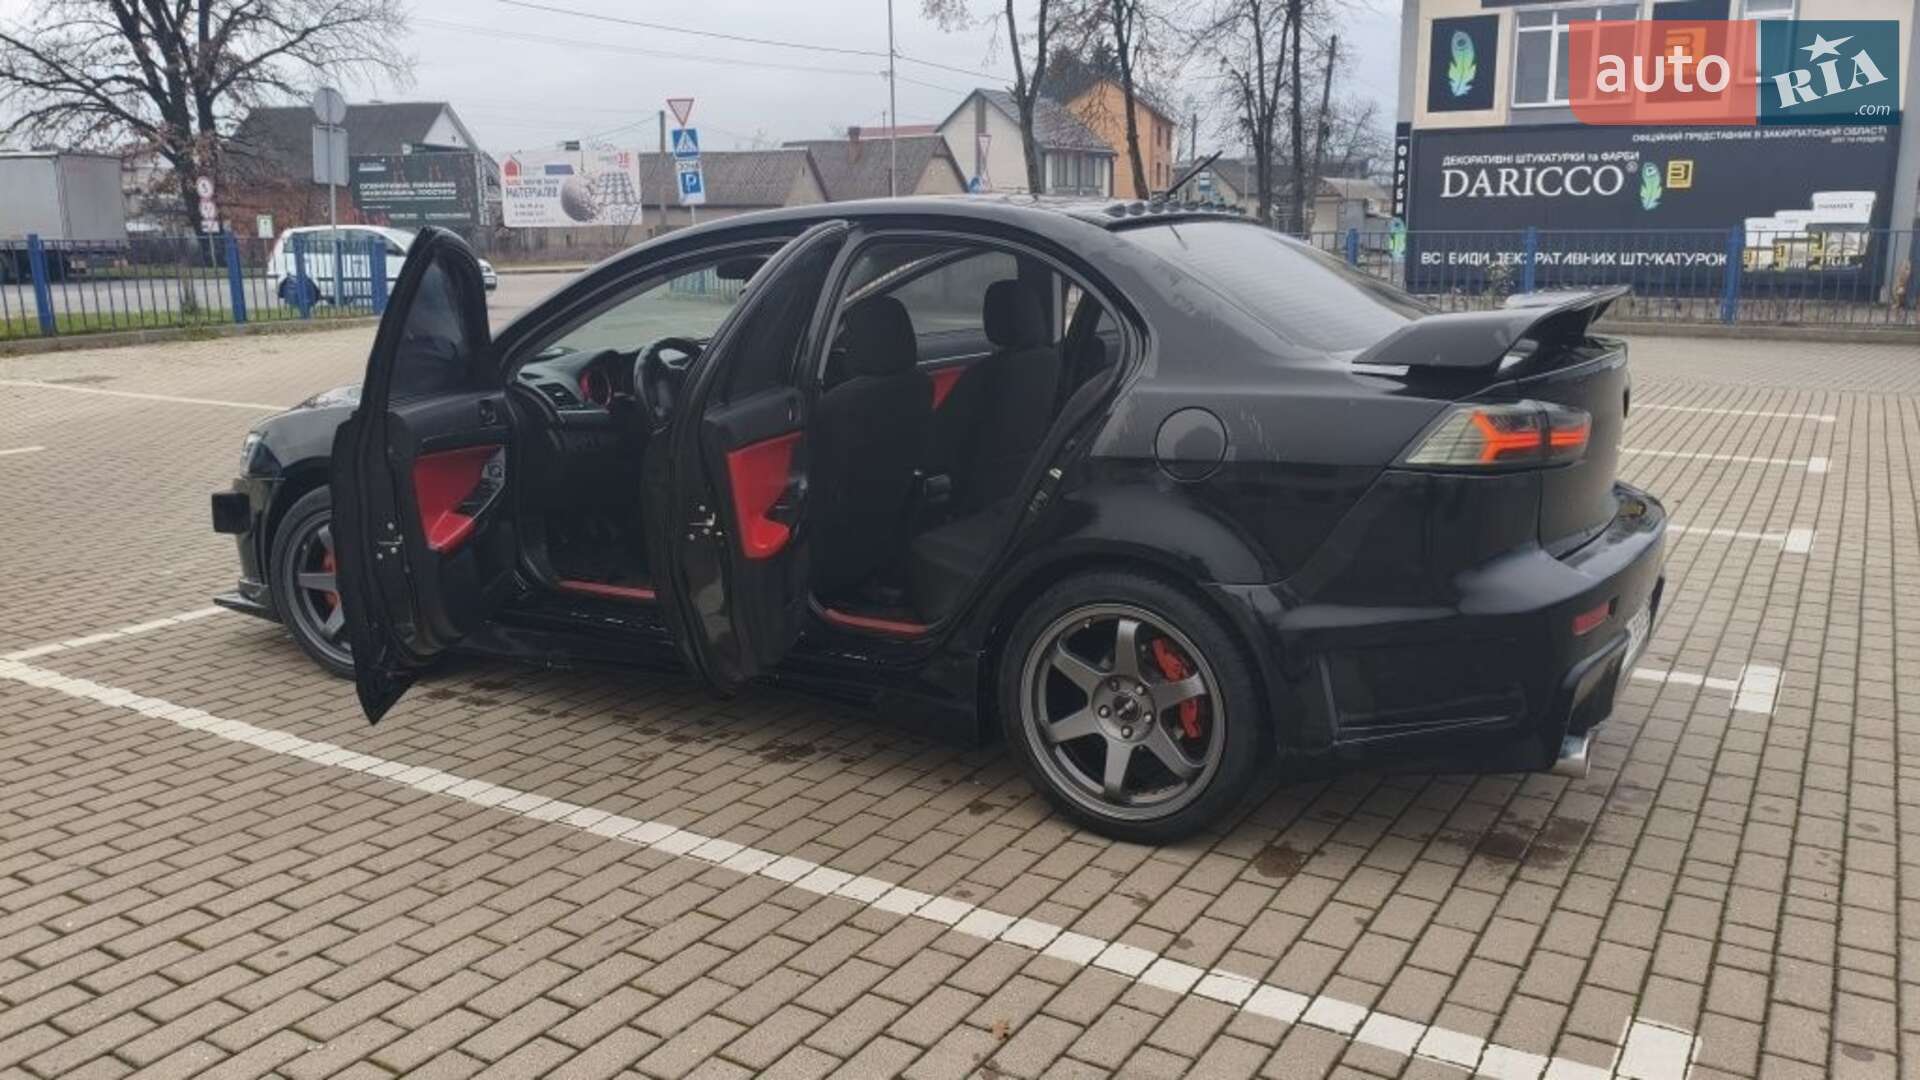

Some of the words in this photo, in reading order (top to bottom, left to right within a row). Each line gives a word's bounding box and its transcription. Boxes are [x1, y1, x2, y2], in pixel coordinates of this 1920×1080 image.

[1442, 154, 1513, 166] ДЕКОРАТИВНІ
[1515, 153, 1585, 164] ШТУКАТУРКИ
[1600, 151, 1640, 162] ФАРБИ
[1440, 165, 1624, 198] DARICCO
[1620, 252, 1728, 266] ШТУКАТУРОК
